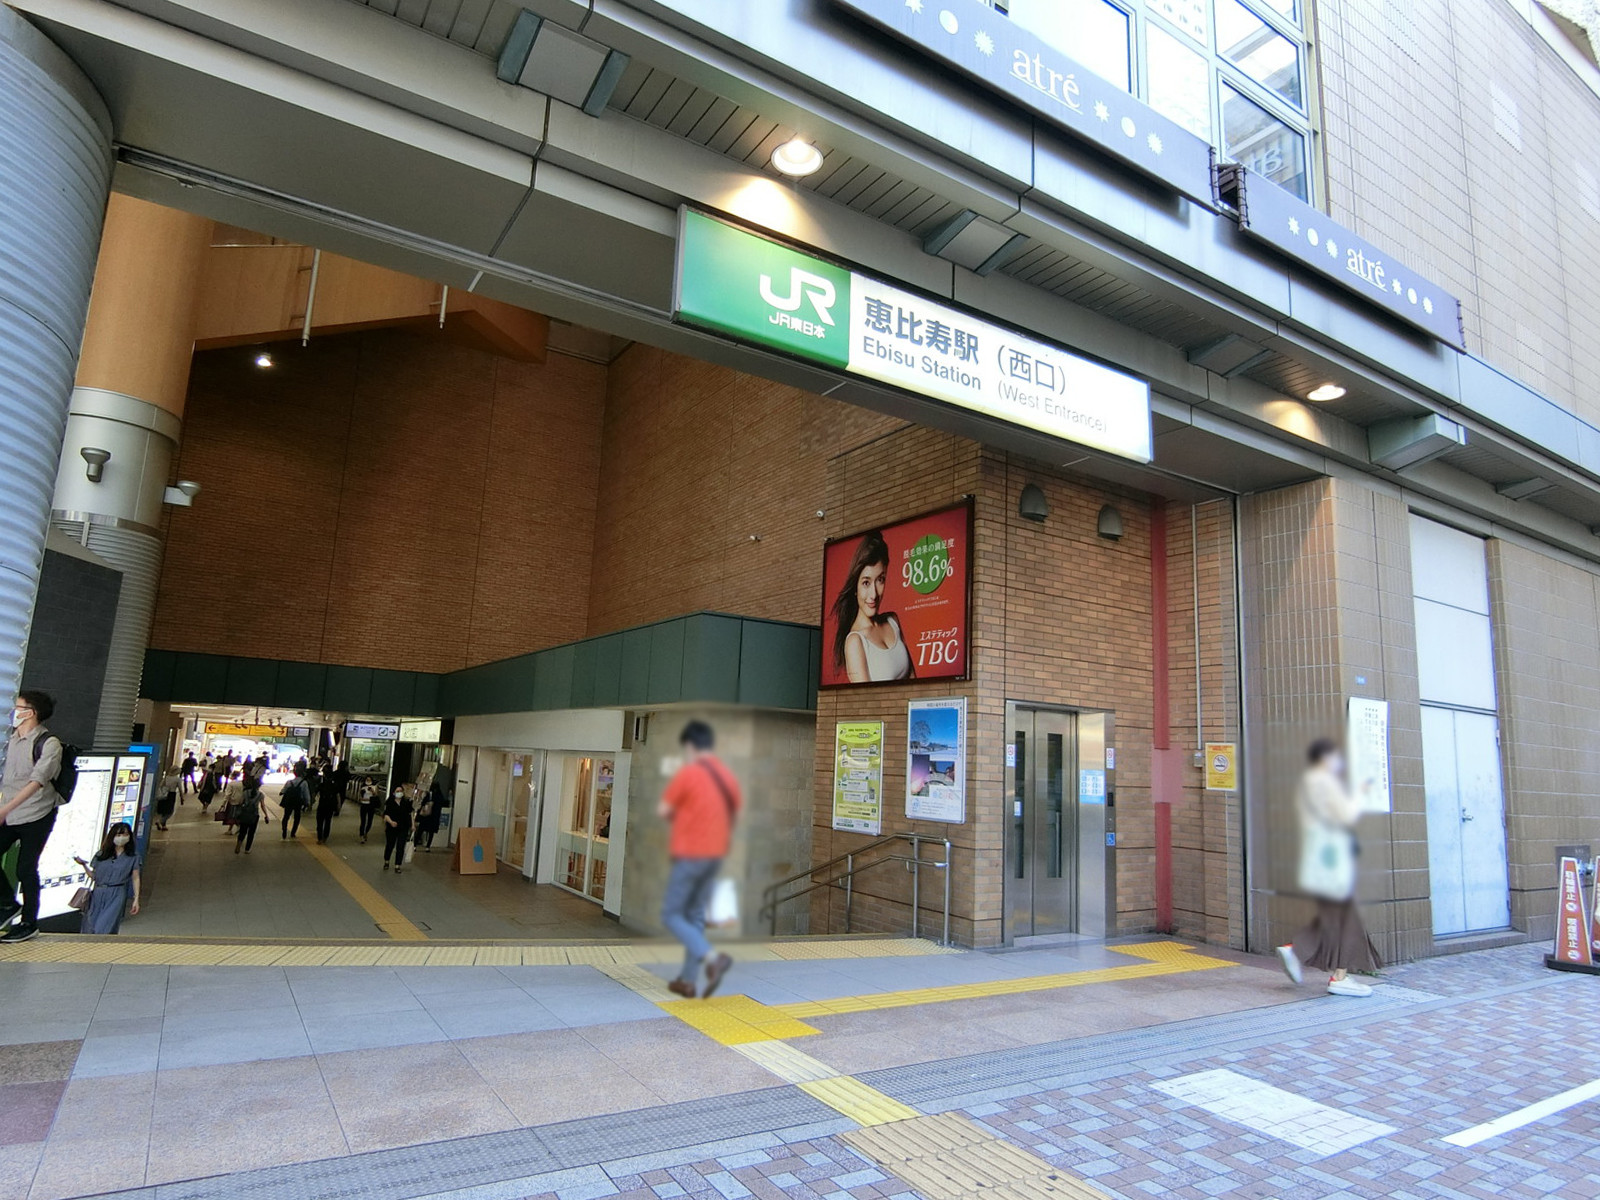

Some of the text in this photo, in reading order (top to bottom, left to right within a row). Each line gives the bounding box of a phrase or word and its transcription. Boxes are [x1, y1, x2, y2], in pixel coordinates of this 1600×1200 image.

[1012, 49, 1081, 108] atré
[1347, 247, 1387, 289] atré
[759, 266, 836, 327] JR
[768, 312, 826, 339] JR東日本
[864, 295, 980, 366] 恵比寿駅
[862, 335, 1108, 434] Ebisu Station (West Entrance)
[902, 554, 953, 588] 98.6%
[916, 639, 958, 666] TBC
[919, 627, 958, 641] エステティック
